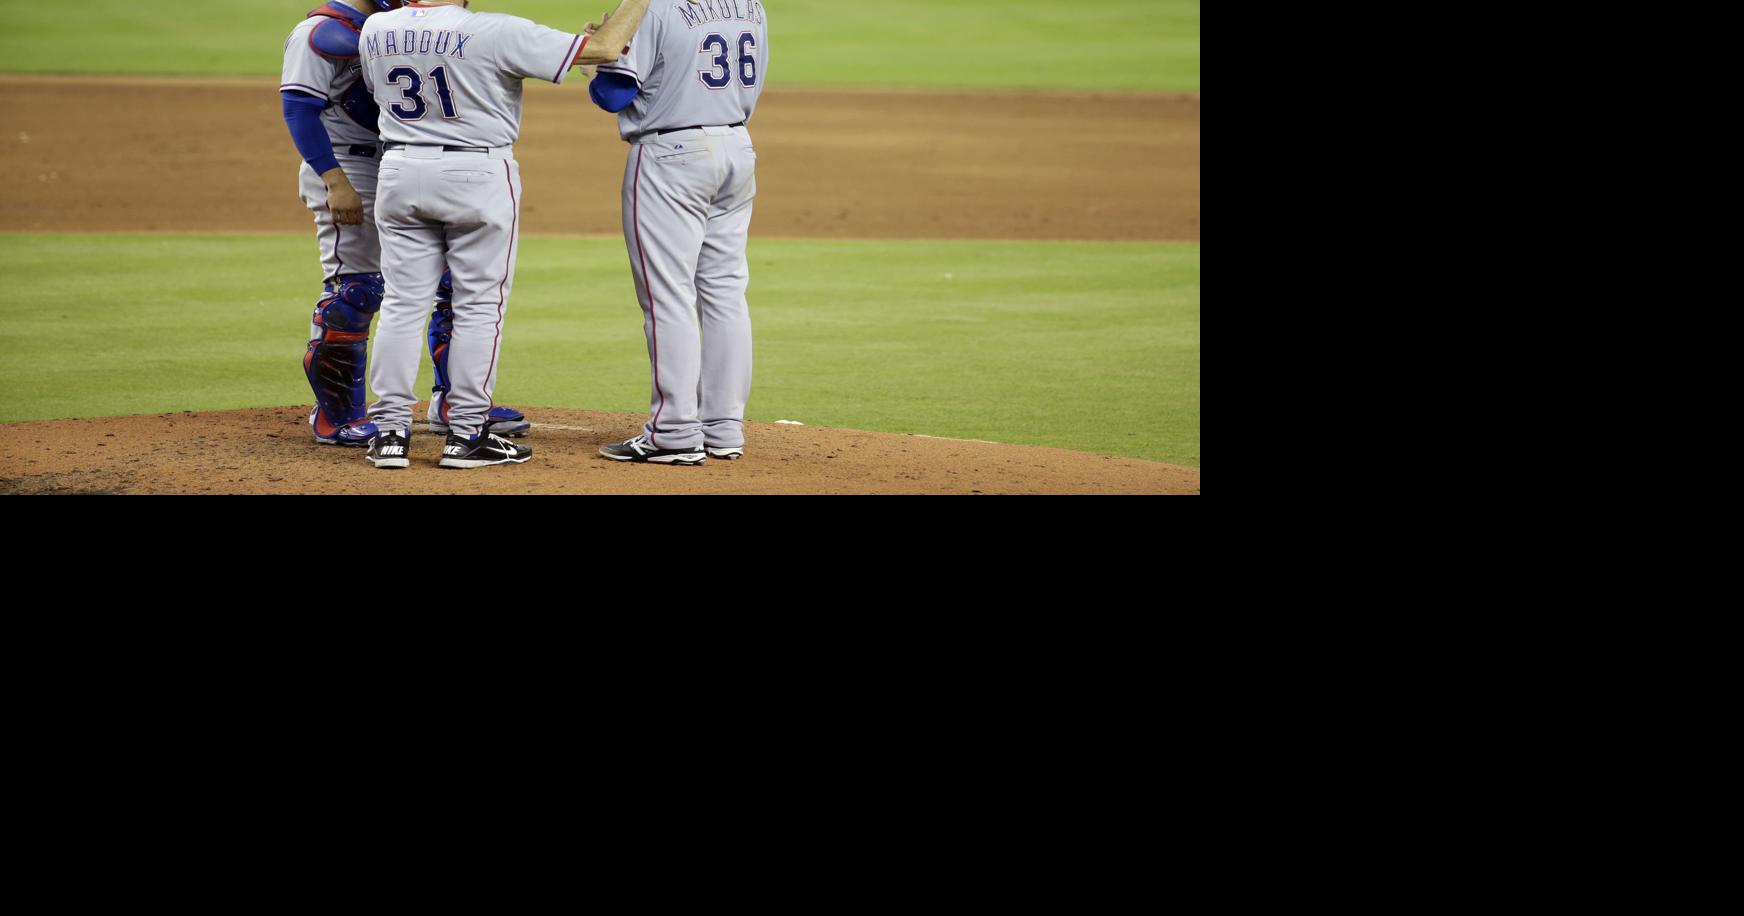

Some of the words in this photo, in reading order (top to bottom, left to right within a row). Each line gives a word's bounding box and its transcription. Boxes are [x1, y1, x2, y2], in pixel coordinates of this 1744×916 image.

[366, 29, 473, 60] MADDUX
[698, 31, 757, 89] 36
[386, 64, 460, 121] 31
[380, 445, 404, 456] NIKE
[443, 445, 461, 456] IKE
